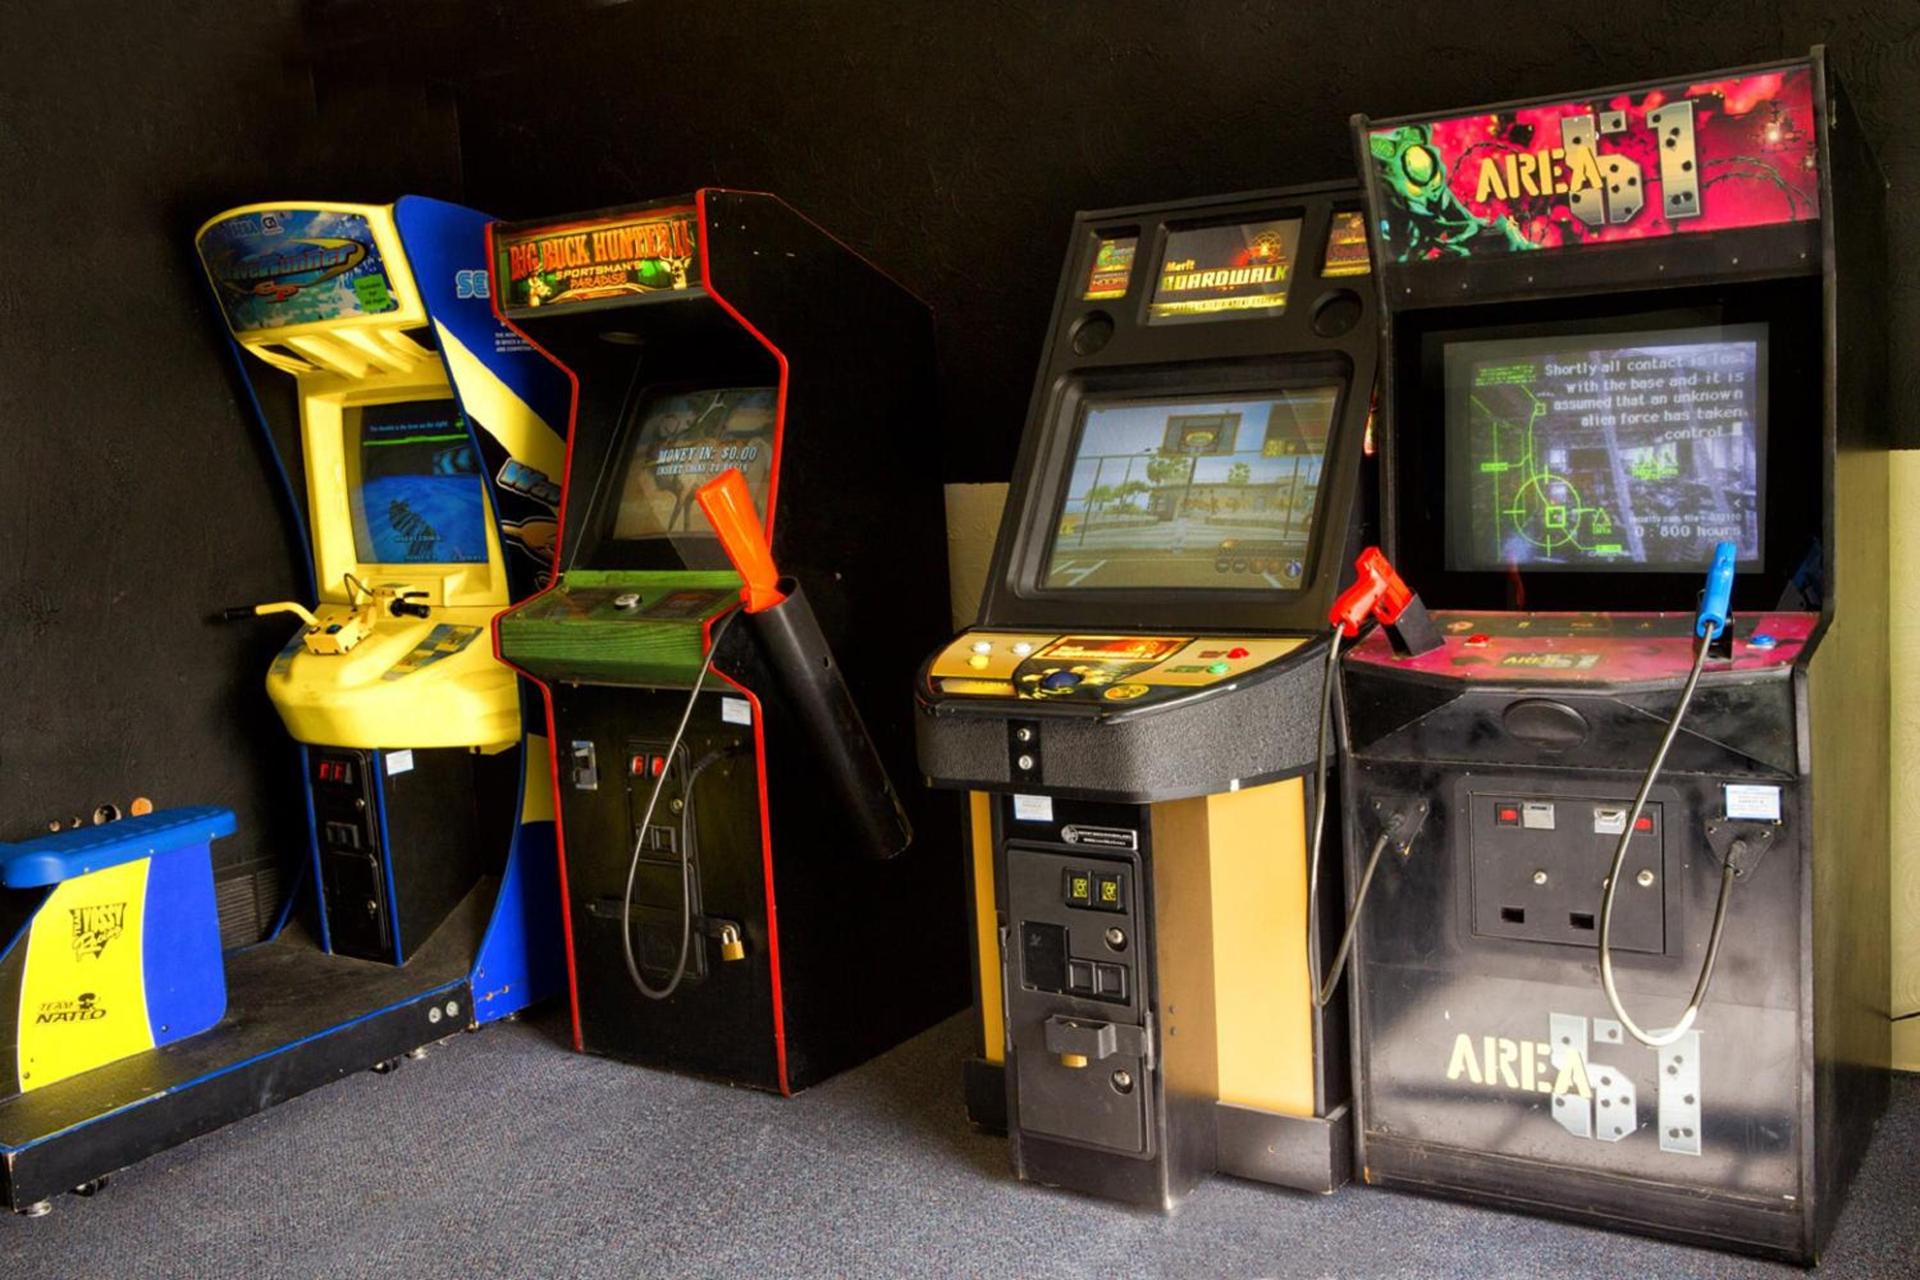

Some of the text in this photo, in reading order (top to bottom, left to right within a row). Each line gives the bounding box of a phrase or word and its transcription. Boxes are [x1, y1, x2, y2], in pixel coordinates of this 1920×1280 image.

[1476, 100, 1701, 226] AREA 51
[510, 241, 539, 281] BIG
[542, 234, 591, 272] BUCK
[592, 222, 673, 263] HUNTER
[556, 260, 642, 280] SPORTSMAN'S
[1165, 259, 1195, 273] Merit
[570, 271, 627, 289] PARADISE
[1161, 265, 1289, 292] BOARDWALK
[1545, 362, 1598, 377] Shortly
[1601, 360, 1621, 373] all
[1627, 356, 1684, 372] contact
[1566, 372, 1745, 393] with the base and it is
[1553, 388, 1744, 411] assumed that an unknown
[1581, 406, 1743, 427] alien force has taken
[1664, 425, 1723, 441] control
[656, 447, 696, 464] MONEY
[721, 446, 758, 460] $0.00
[1446, 1012, 1703, 1156] AREA 51
